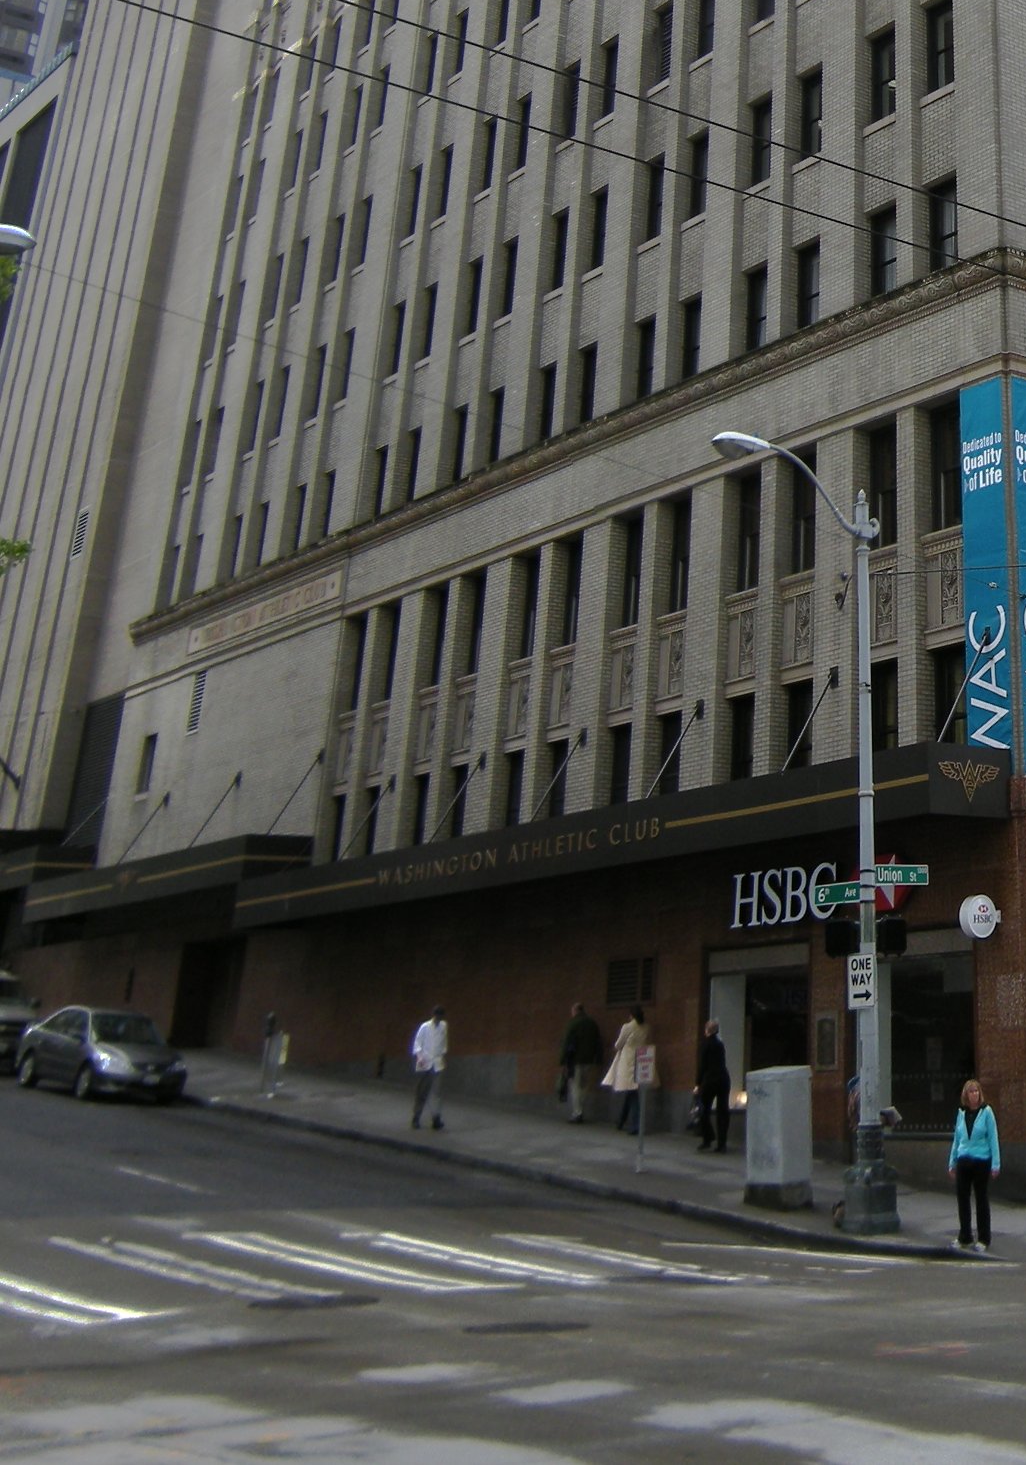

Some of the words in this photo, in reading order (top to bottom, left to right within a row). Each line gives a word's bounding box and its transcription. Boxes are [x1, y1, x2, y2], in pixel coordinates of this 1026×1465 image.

[962, 432, 994, 454] Dedicated
[994, 431, 1002, 444] to
[963, 447, 1003, 474] Quality
[968, 472, 978, 492] of
[979, 466, 1003, 488] Life
[378, 847, 498, 884] WASHINGTON
[508, 828, 598, 863] ATHLETIC
[608, 817, 660, 846] CLUB
[877, 867, 903, 883] Union
[909, 871, 917, 882] St
[730, 862, 837, 929] HSBC
[845, 888, 856, 897] Ave
[973, 914, 993, 924] HSBC
[850, 957, 872, 972] ONE
[850, 972, 873, 987] WAY
